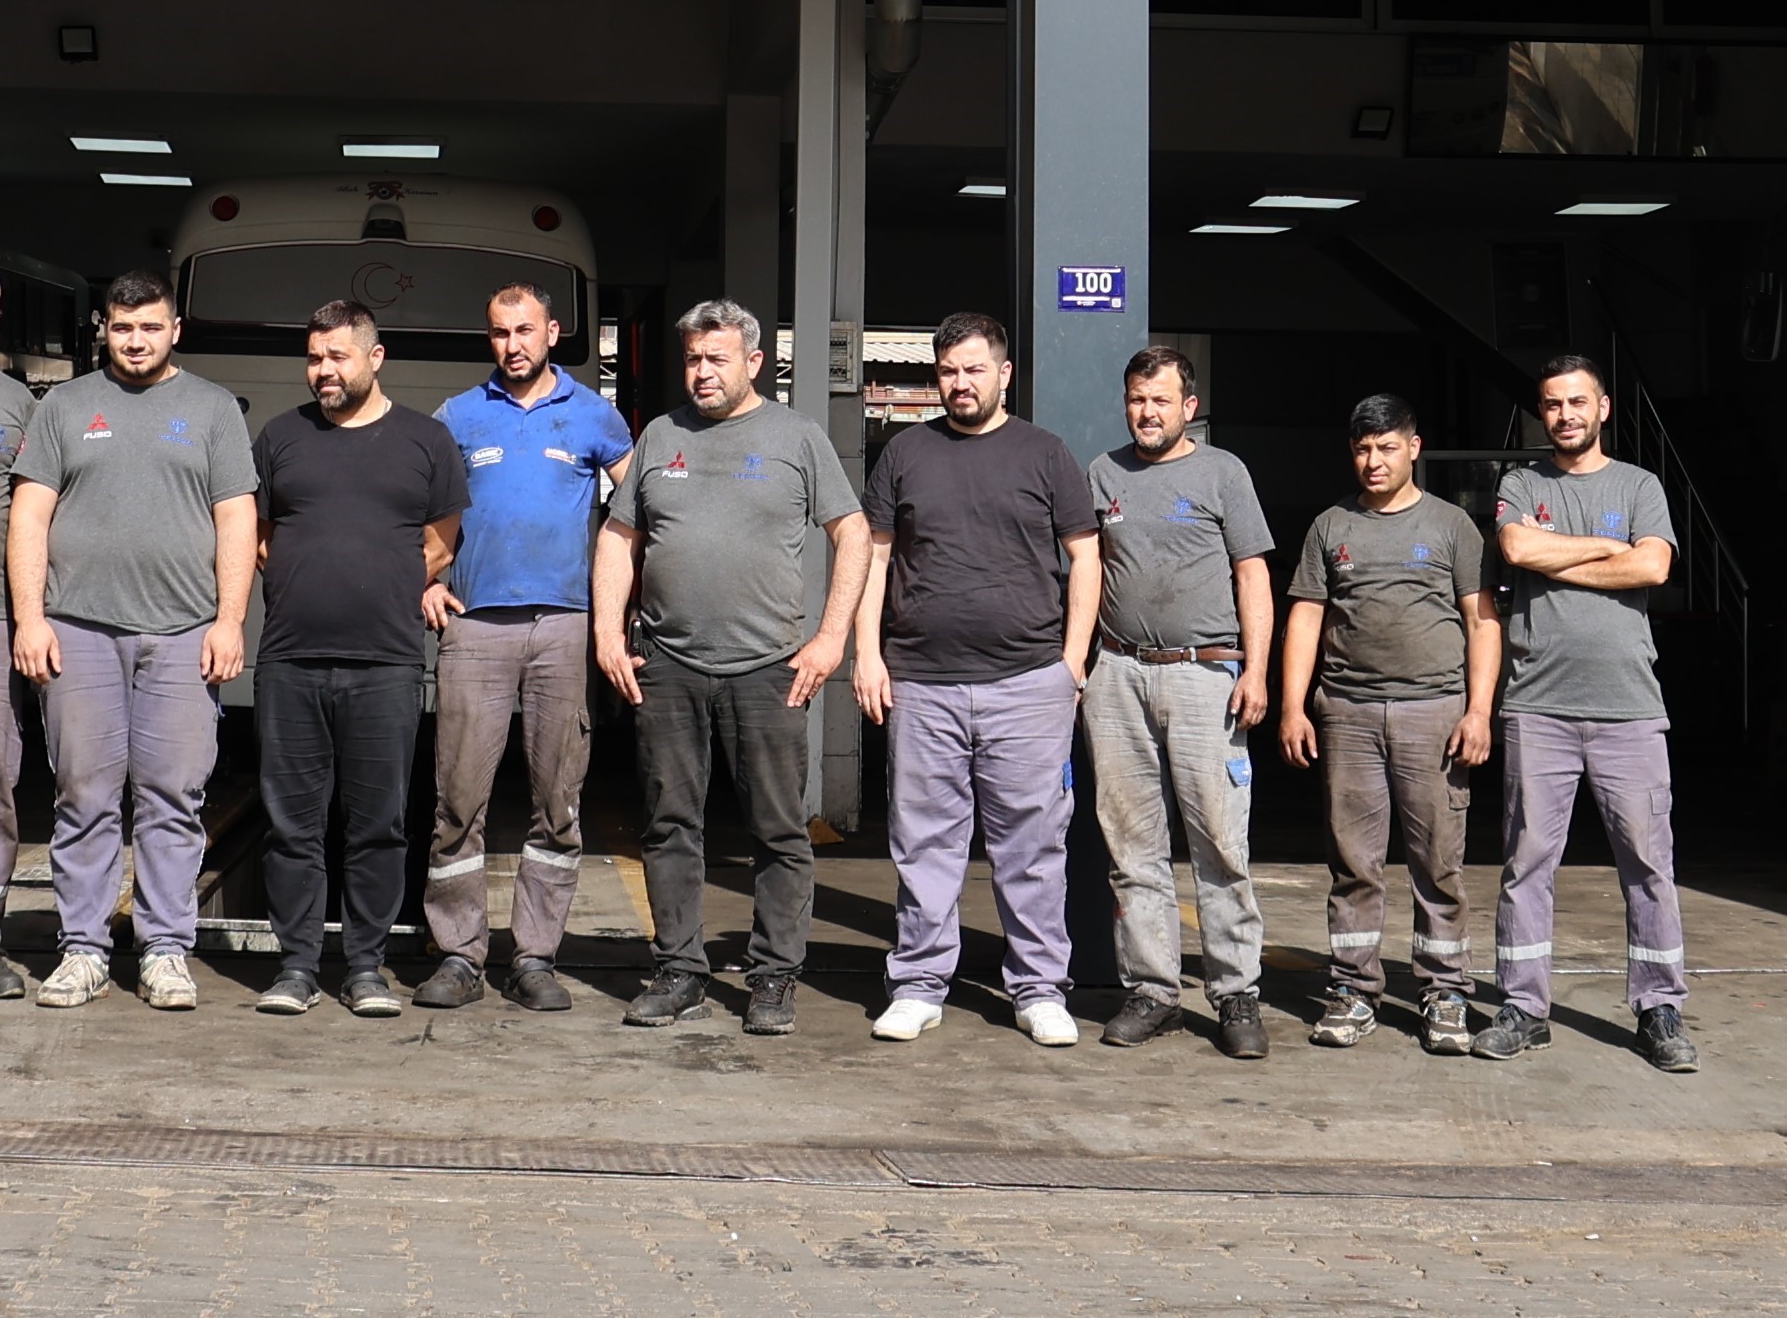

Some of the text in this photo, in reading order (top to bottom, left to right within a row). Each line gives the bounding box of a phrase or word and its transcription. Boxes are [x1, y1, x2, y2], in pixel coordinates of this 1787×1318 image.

[1075, 272, 1113, 294] 100
[83, 430, 112, 441] FUSO
[661, 470, 689, 479] FUSO
